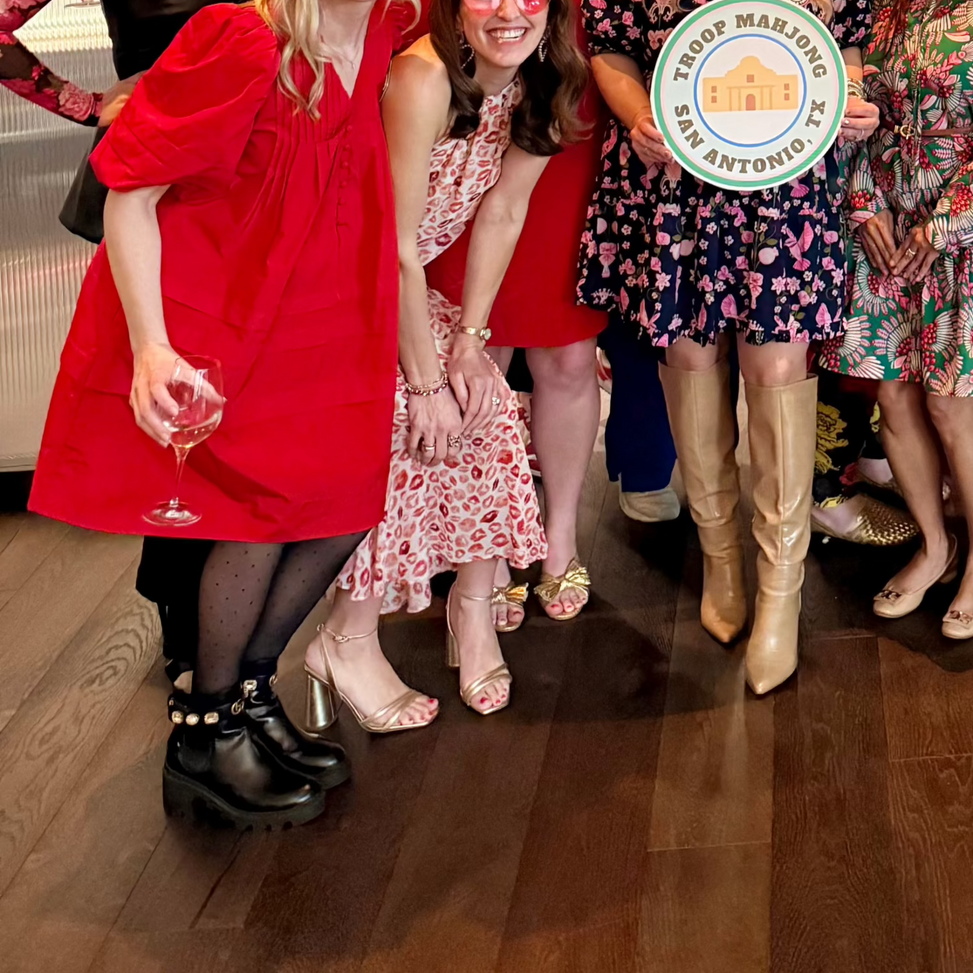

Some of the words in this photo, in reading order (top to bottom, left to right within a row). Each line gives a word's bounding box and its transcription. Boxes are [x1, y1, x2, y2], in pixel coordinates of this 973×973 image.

[673, 19, 727, 82] TROOP
[735, 13, 828, 79] MAHJONG
[674, 104, 705, 151] SAN
[703, 137, 814, 174] ANTONIO,
[805, 99, 826, 129] TX
